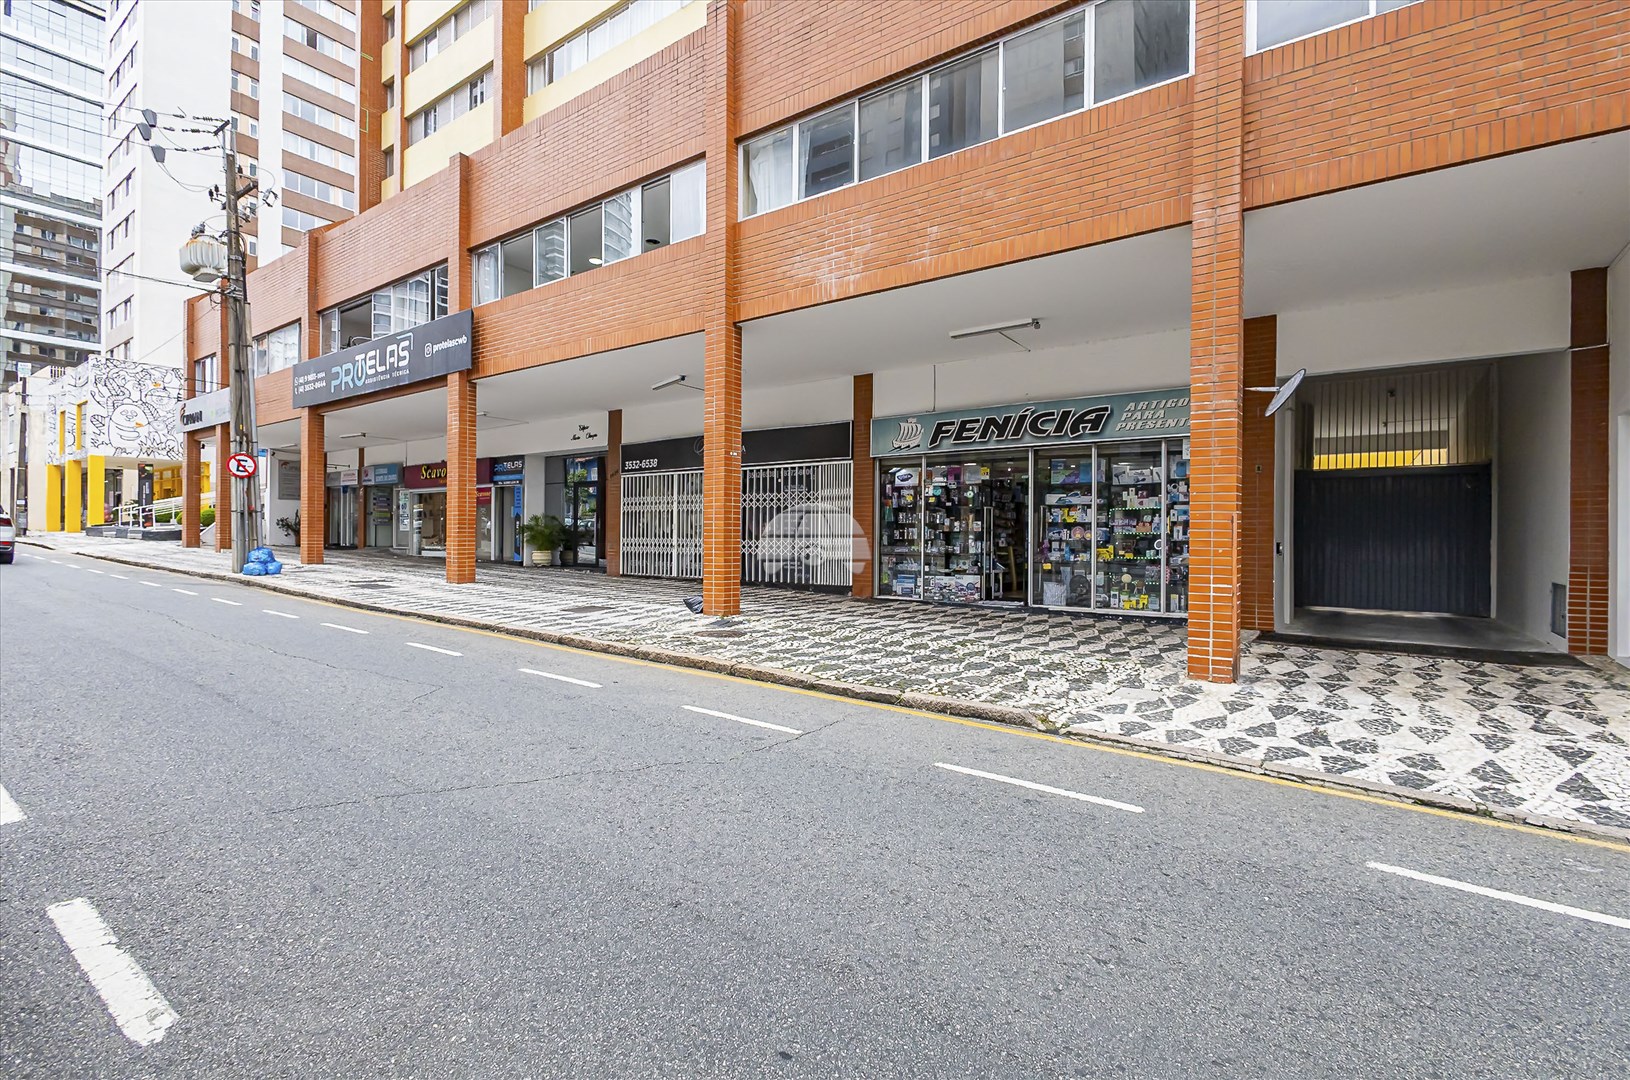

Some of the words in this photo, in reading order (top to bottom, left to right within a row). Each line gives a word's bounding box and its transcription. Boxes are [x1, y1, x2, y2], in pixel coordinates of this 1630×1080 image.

[433, 335, 468, 353] protelascwb
[331, 341, 410, 393] PROTELAS
[1121, 410, 1165, 421] PARA
[928, 406, 1111, 448] FENÍCIA
[1115, 418, 1190, 432] PRESENT
[236, 459, 247, 472] E
[624, 459, 658, 470] 3532-6538
